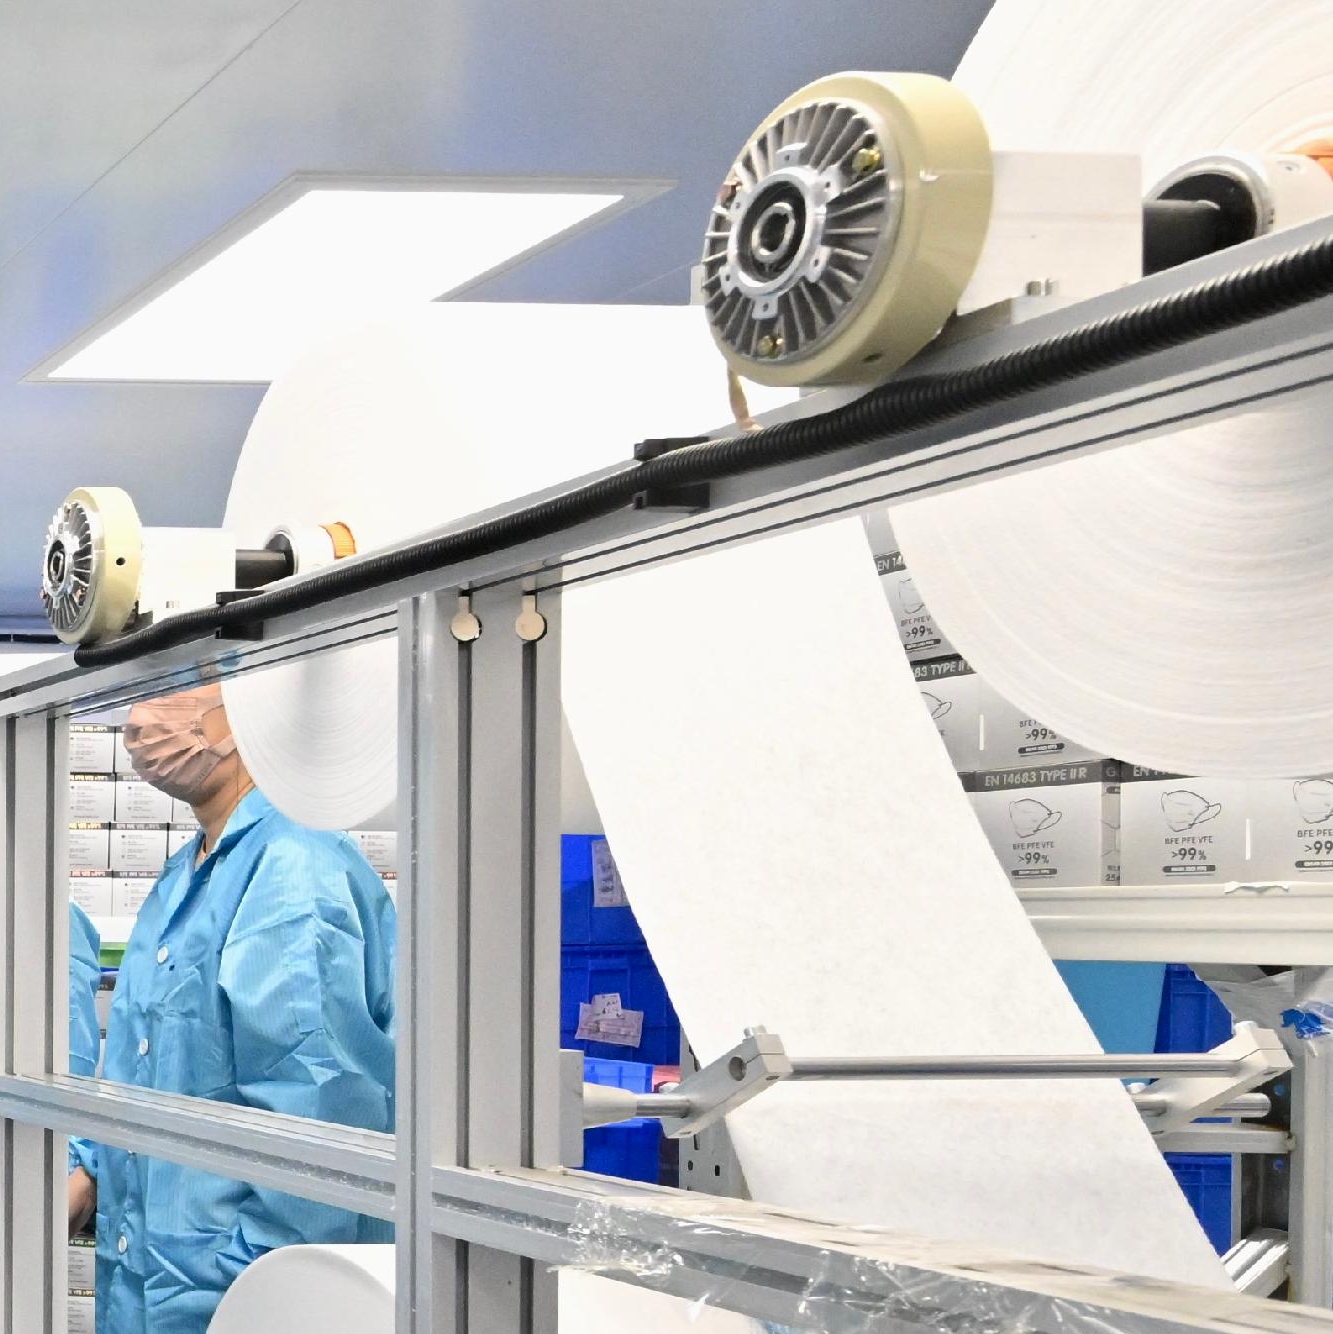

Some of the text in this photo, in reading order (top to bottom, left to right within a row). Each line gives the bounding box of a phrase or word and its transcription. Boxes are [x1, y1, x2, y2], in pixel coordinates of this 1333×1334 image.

[877, 559, 890, 572] EN
[931, 661, 956, 675] TYPE
[985, 775, 1000, 787] EN
[1003, 770, 1037, 785] 14683
[1040, 768, 1067, 783] TYPE
[1297, 829, 1314, 838] BFE
[1018, 851, 1050, 864] >99%
[1170, 847, 1207, 861] >99%
